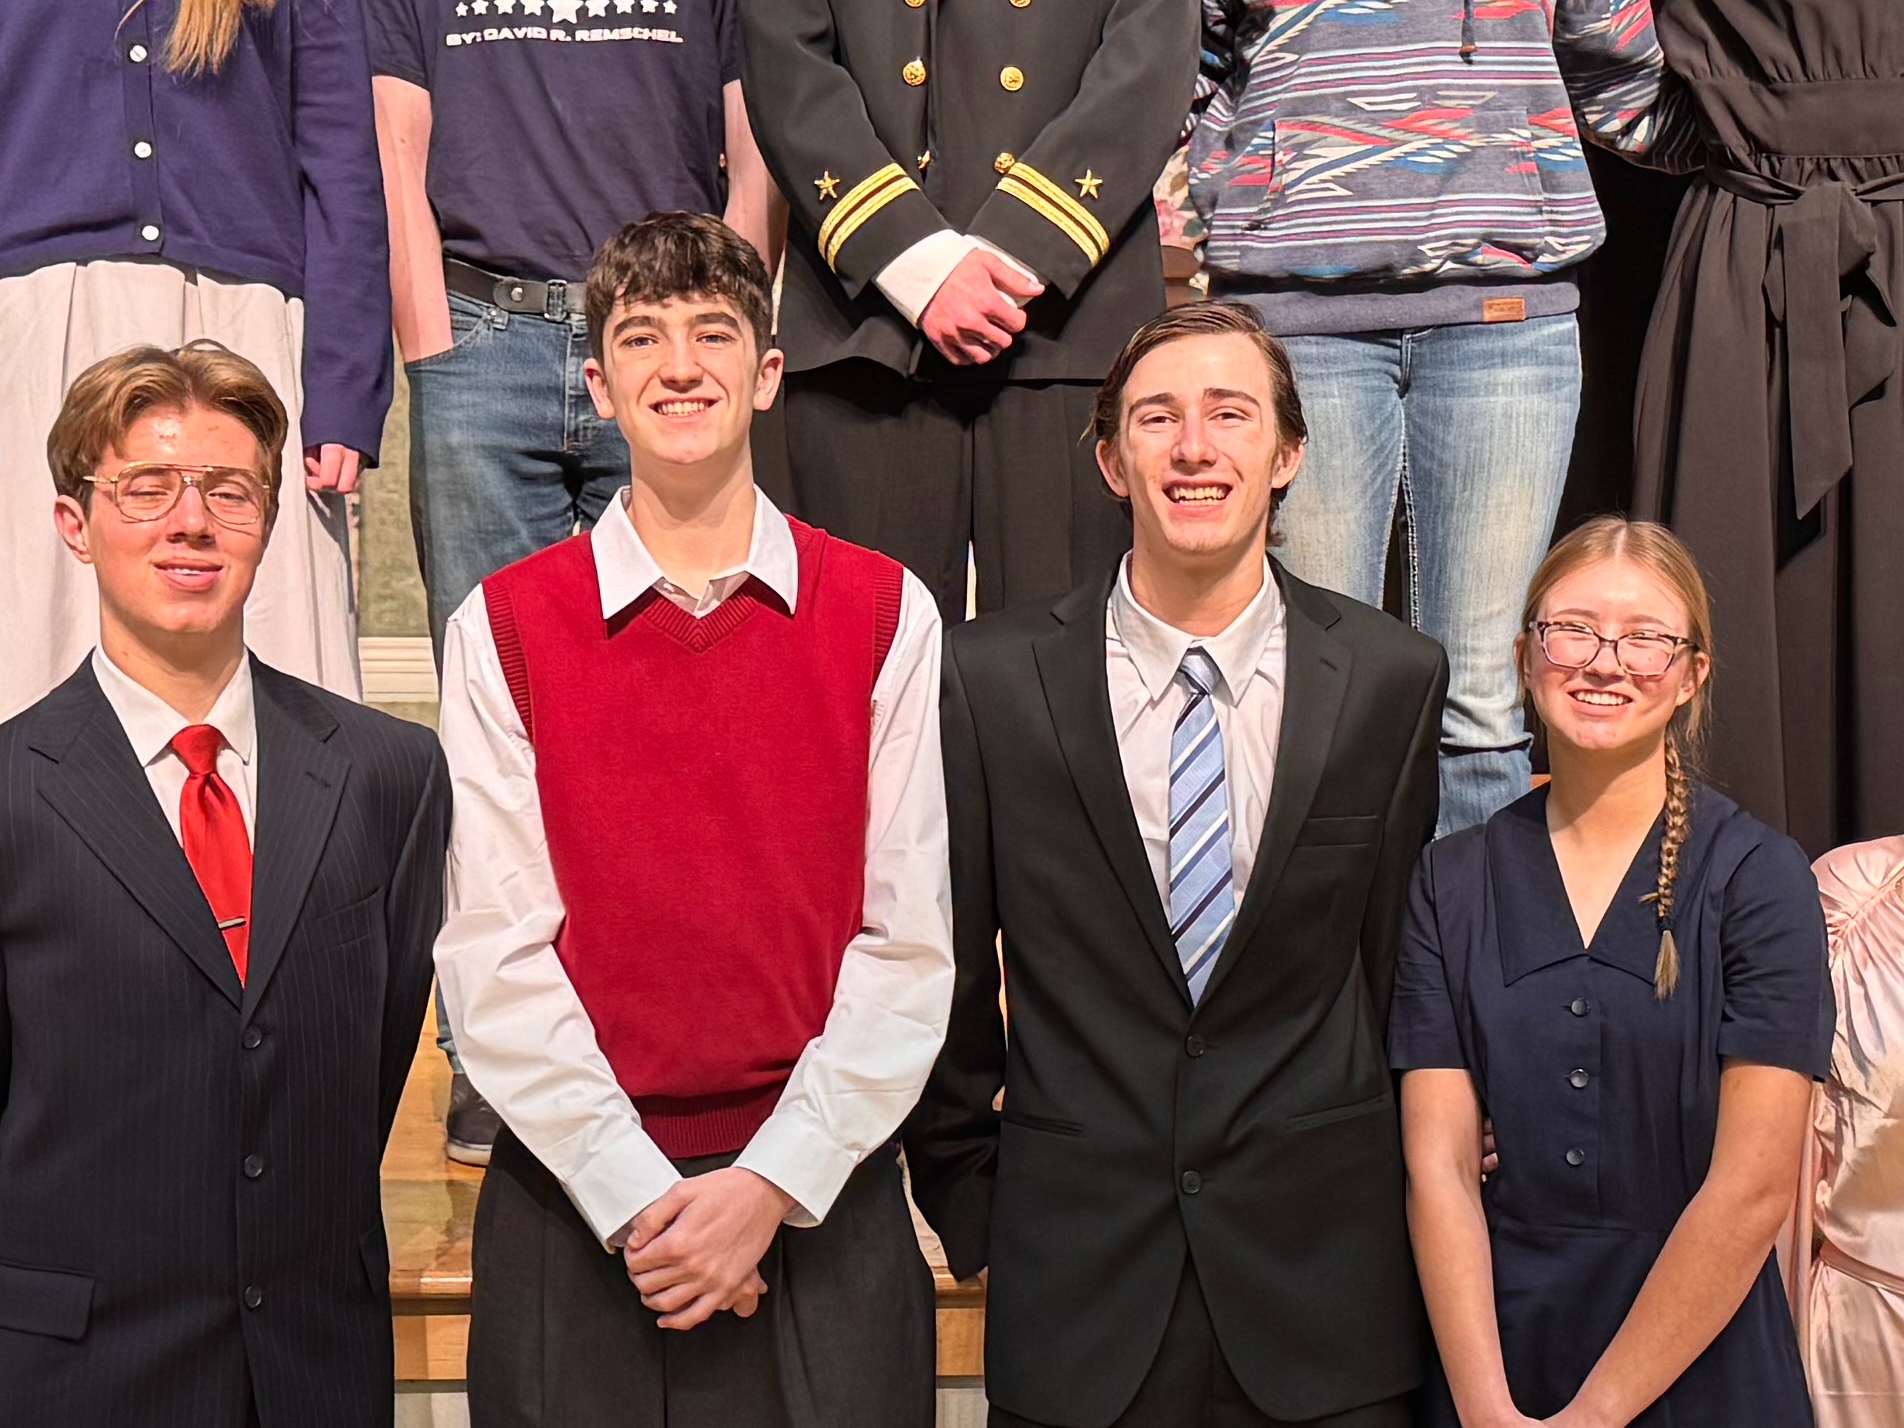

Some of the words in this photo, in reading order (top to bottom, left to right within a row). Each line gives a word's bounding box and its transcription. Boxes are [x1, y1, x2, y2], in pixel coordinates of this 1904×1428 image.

[445, 31, 482, 47] BY:
[482, 26, 548, 41] DAVID
[549, 28, 573, 42] R.
[574, 26, 685, 44] REMSCHEL
